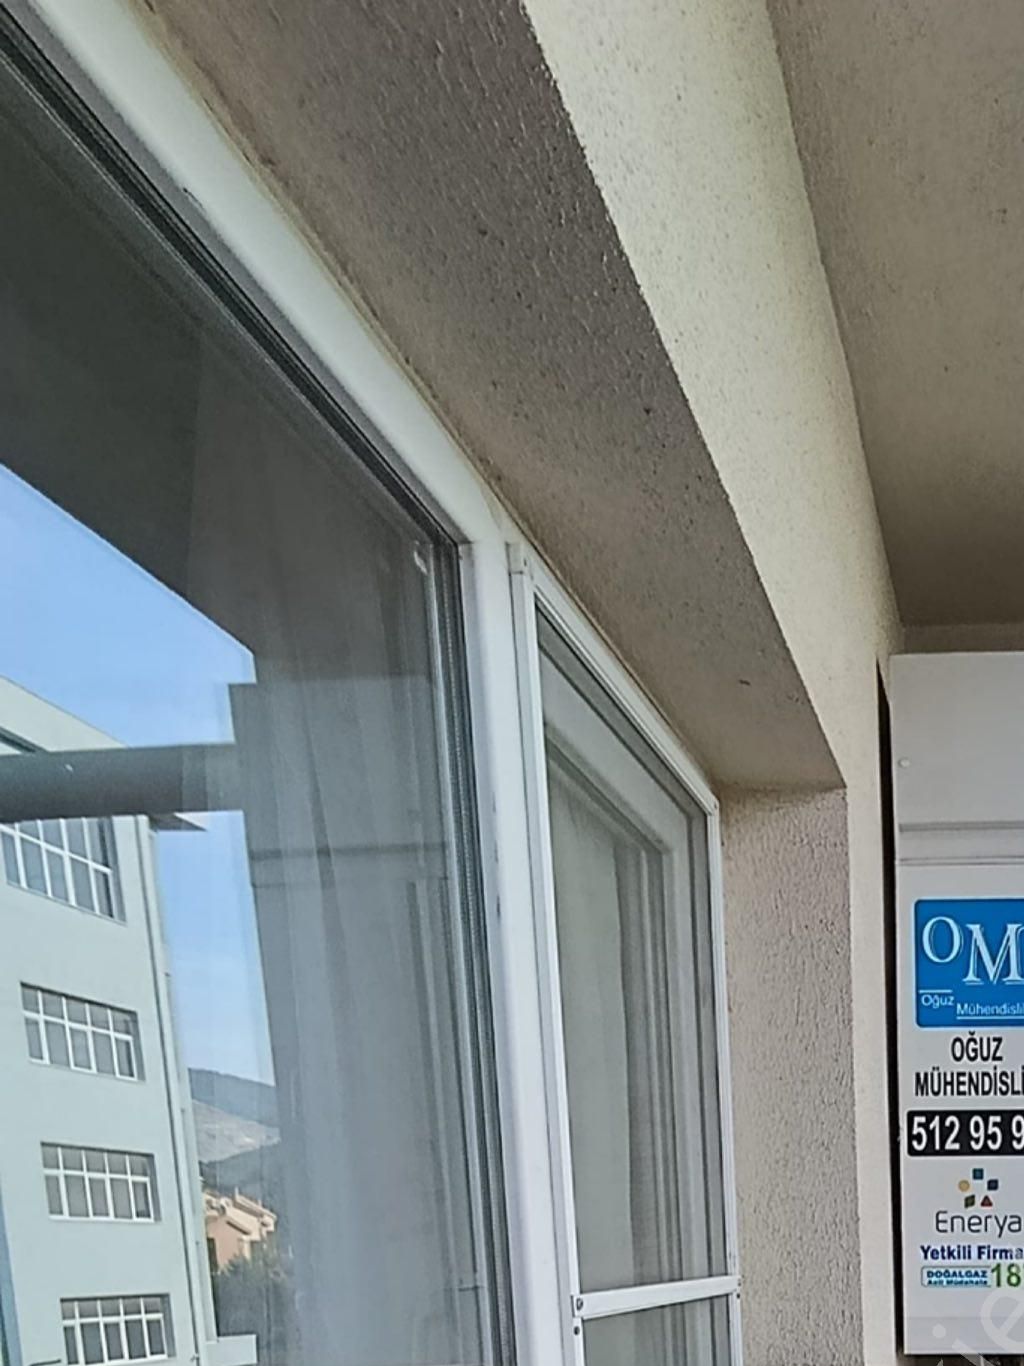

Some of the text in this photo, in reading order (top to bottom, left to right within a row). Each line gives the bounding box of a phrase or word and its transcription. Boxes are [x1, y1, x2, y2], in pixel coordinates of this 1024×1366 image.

[921, 994, 955, 1009] Oğuz
[951, 1031, 1003, 1062] OĞUZ
[911, 1115, 961, 1151] 512
[969, 1115, 1002, 1151] 95
[935, 1210, 1022, 1239] Enerya
[920, 1245, 972, 1261] Yetkili
